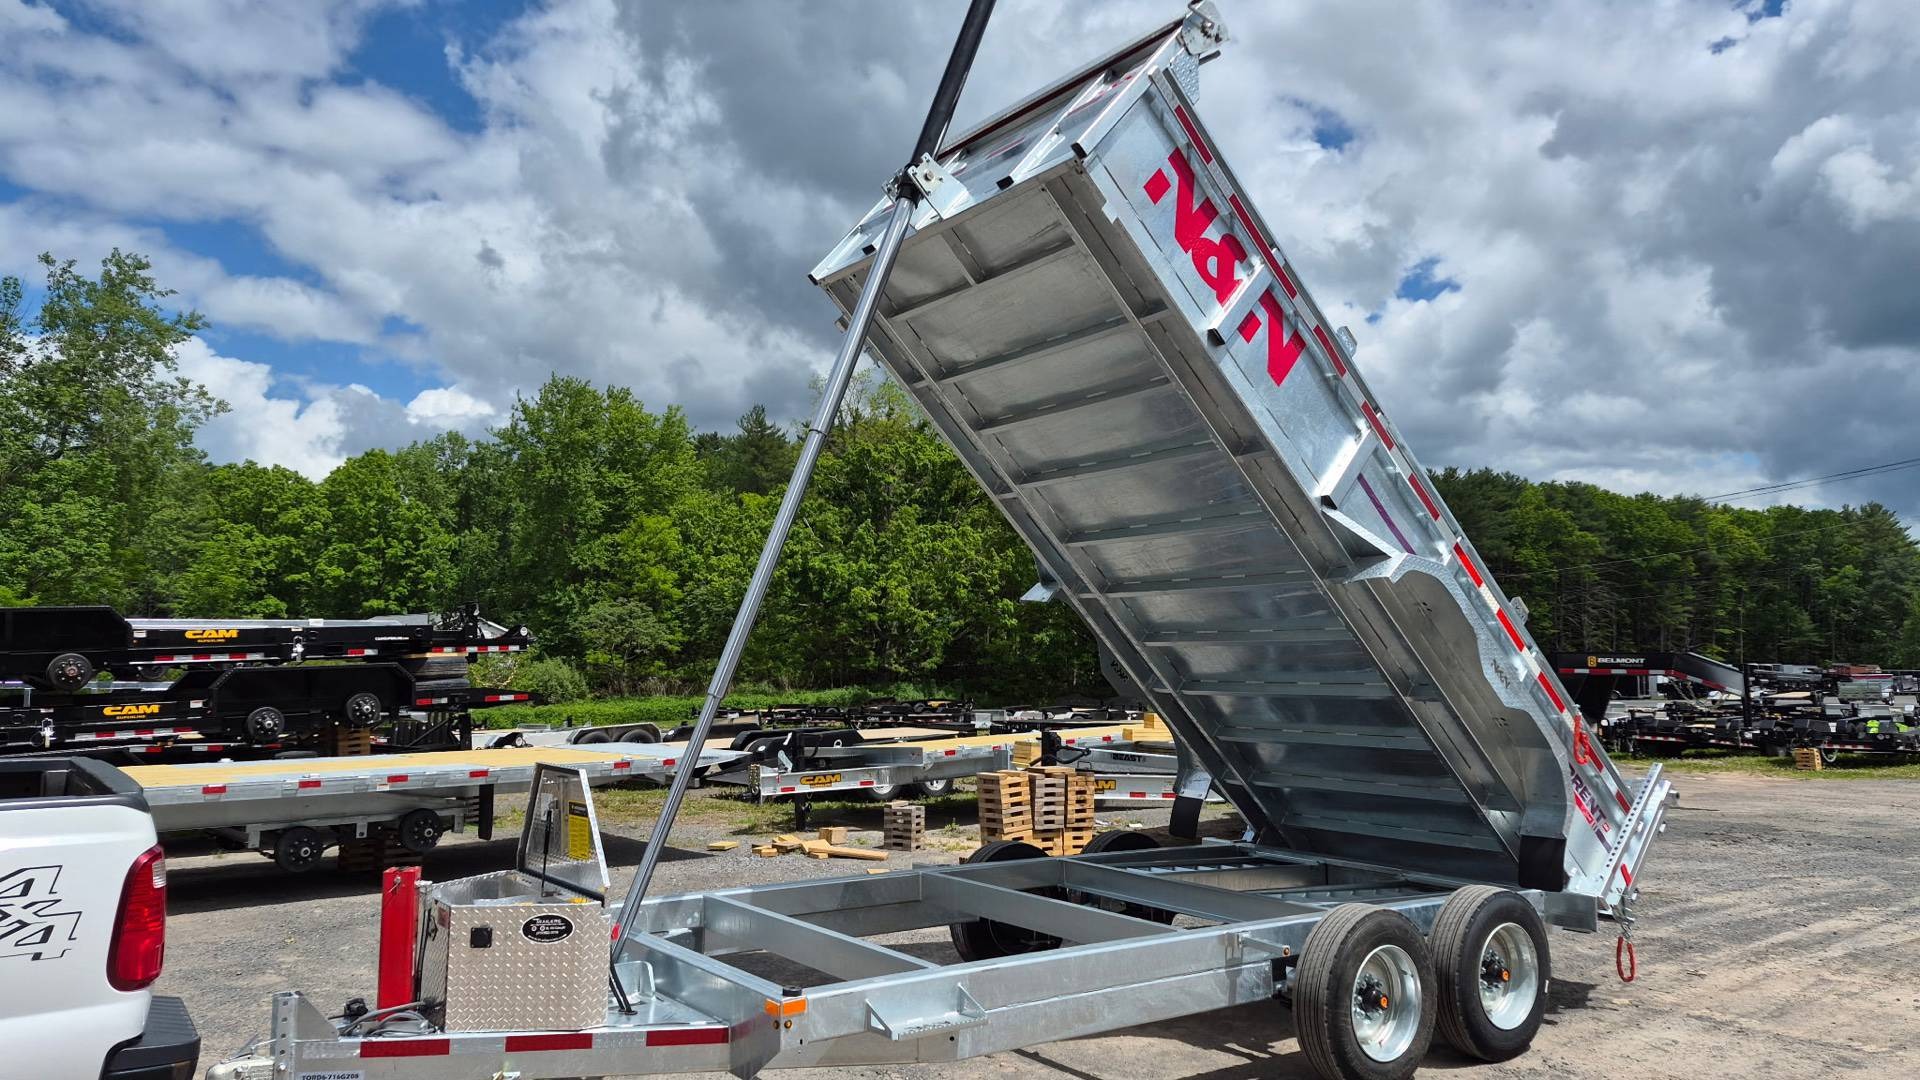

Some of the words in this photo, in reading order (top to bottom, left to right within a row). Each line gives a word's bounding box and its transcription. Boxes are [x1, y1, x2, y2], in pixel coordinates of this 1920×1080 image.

[185, 629, 239, 639] CAM
[103, 704, 161, 716] CAM
[800, 773, 841, 785] CAM
[1095, 780, 1116, 789] AM
